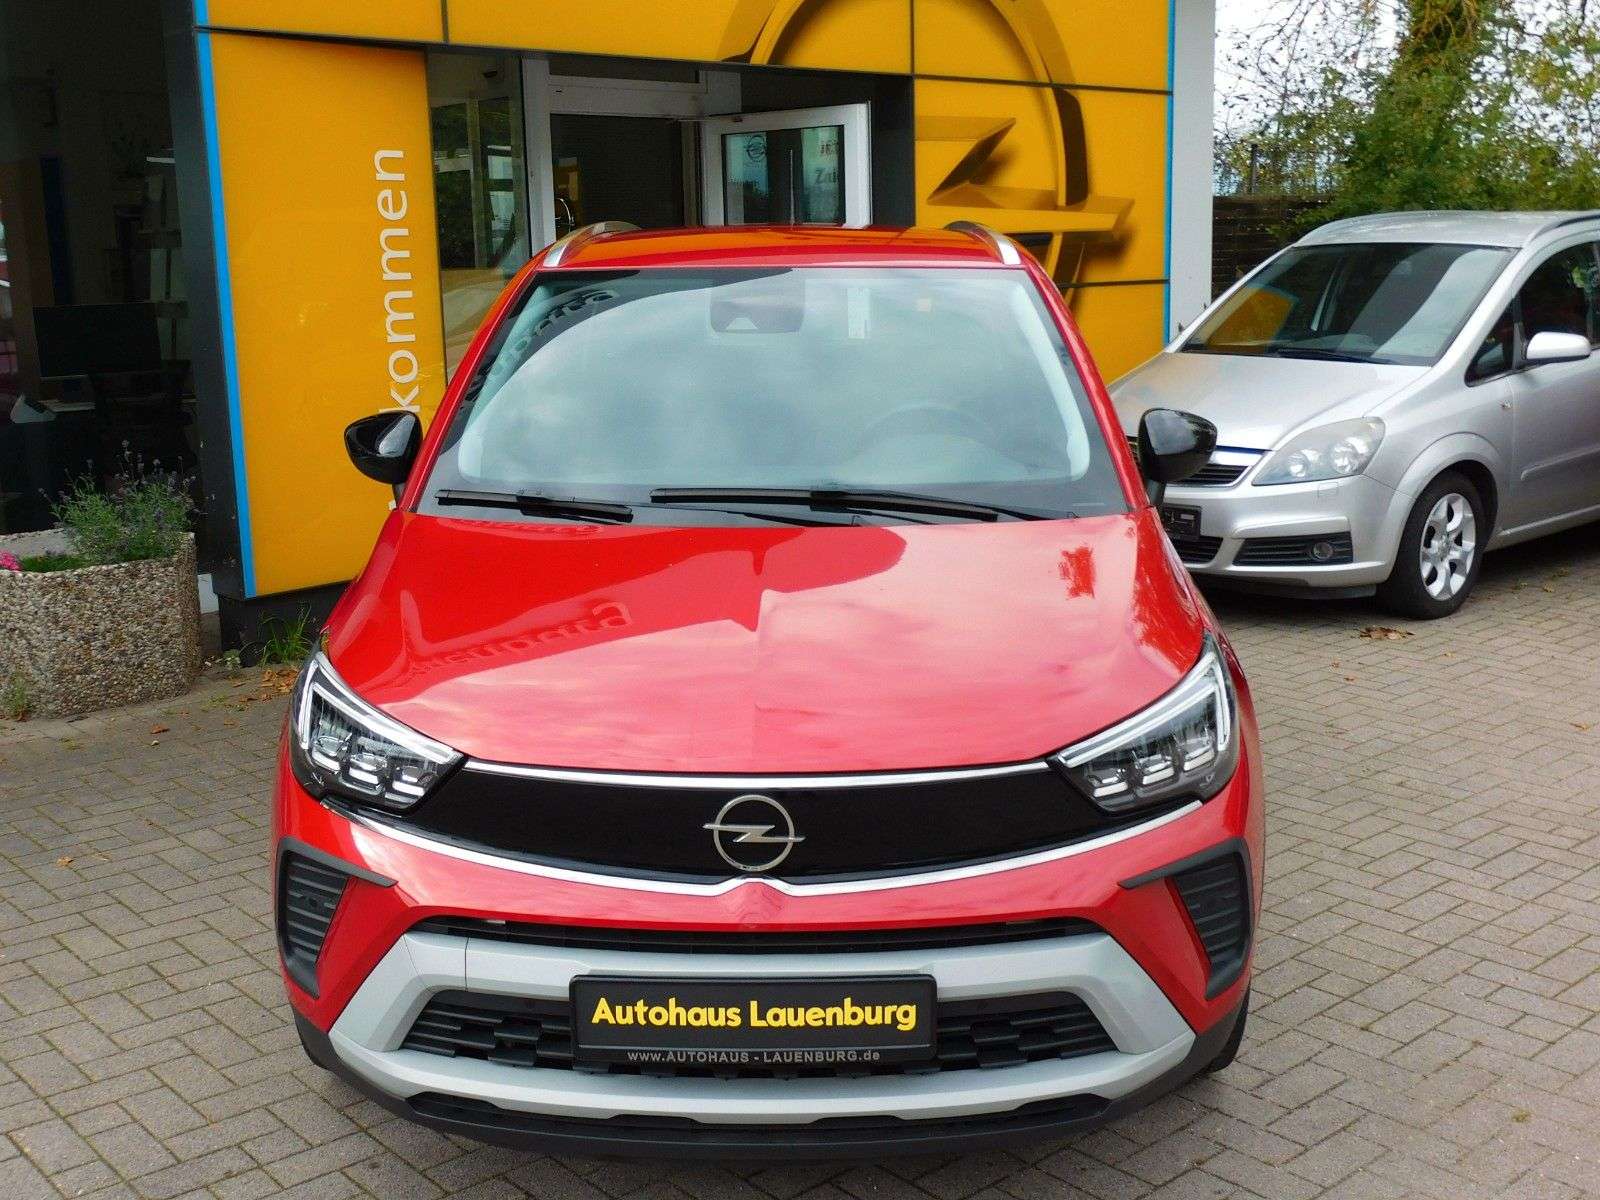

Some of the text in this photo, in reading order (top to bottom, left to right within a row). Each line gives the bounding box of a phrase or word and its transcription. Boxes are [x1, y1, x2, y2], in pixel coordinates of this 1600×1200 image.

[374, 148, 421, 413] kommen
[591, 997, 917, 1031] Autohaus Lauenburg
